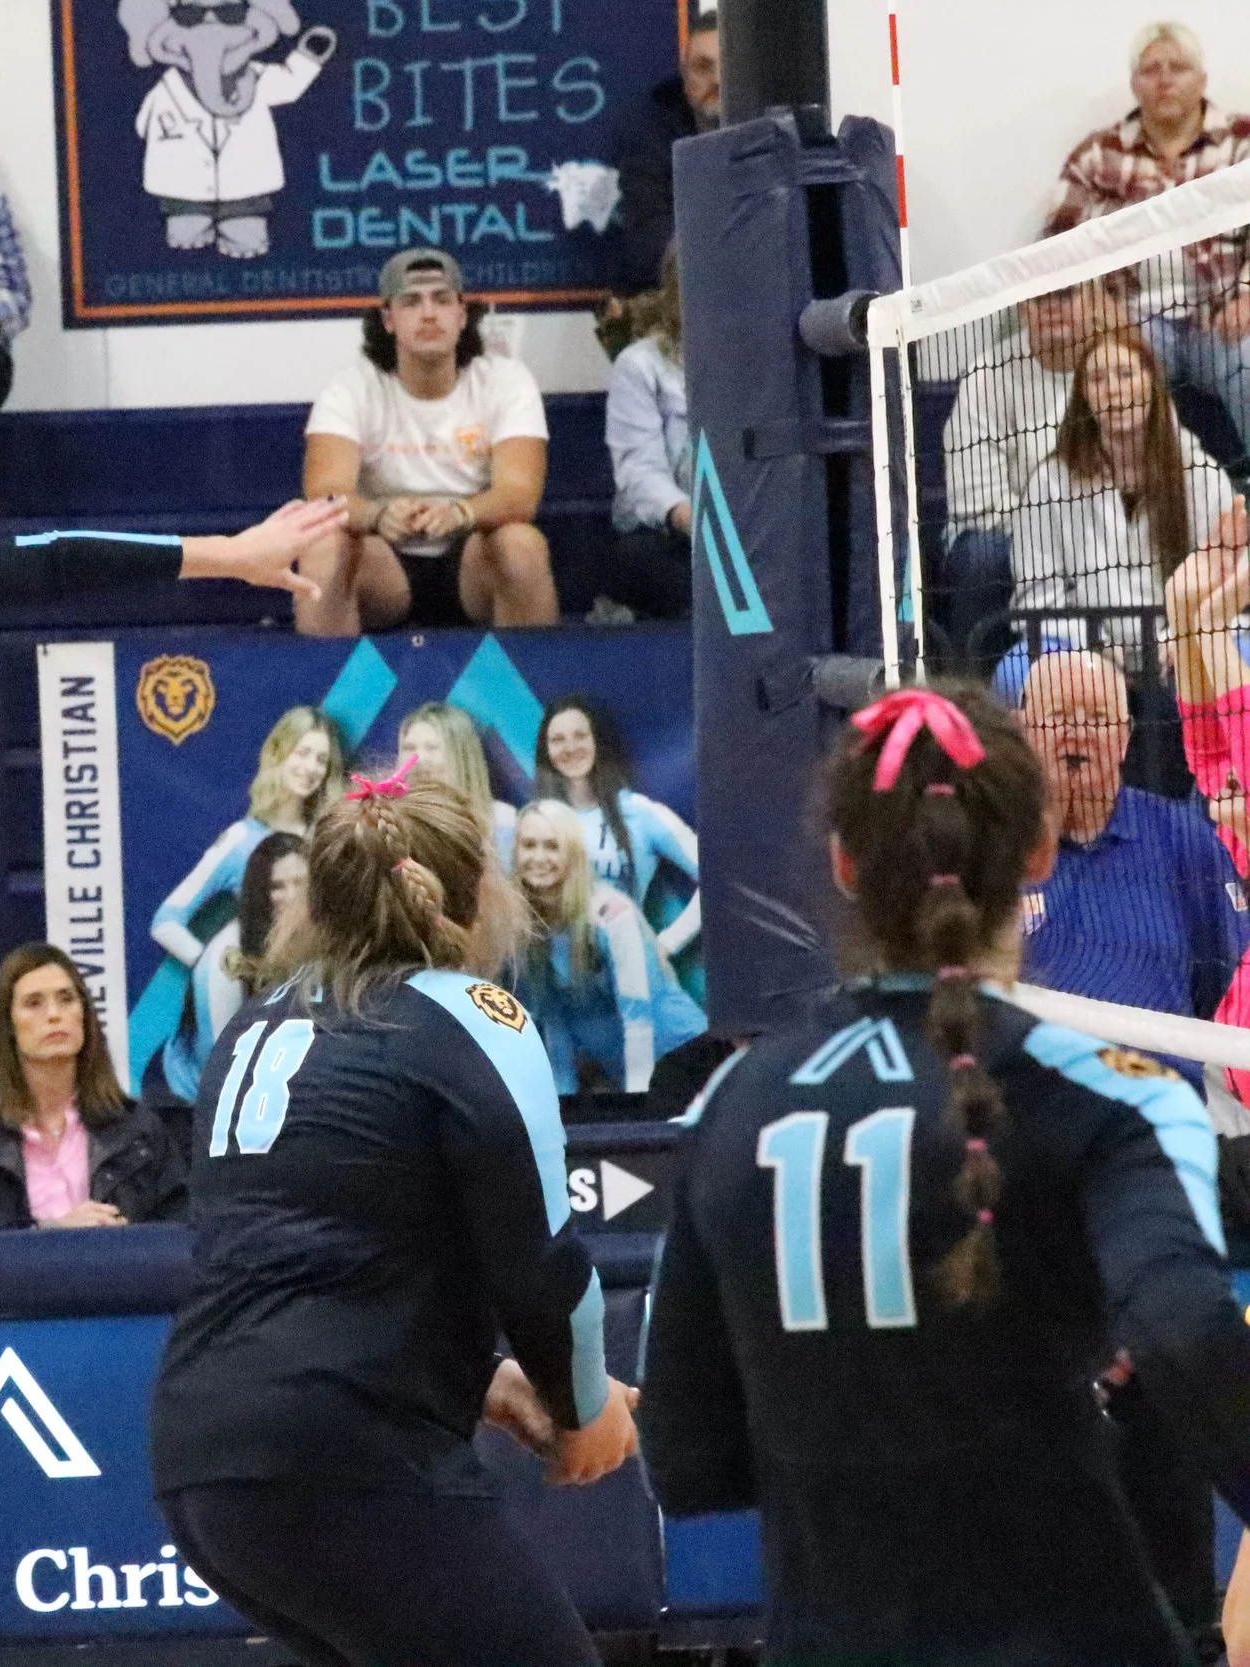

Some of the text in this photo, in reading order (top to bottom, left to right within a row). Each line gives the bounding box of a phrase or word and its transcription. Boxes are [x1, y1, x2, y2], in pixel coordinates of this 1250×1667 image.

[354, 53, 605, 131] BITES
[320, 146, 540, 192] LASER
[311, 202, 554, 248] DENTAL
[59, 676, 102, 870] CHRISTIAN
[209, 1018, 315, 1157] 18
[756, 1106, 918, 1332] 11
